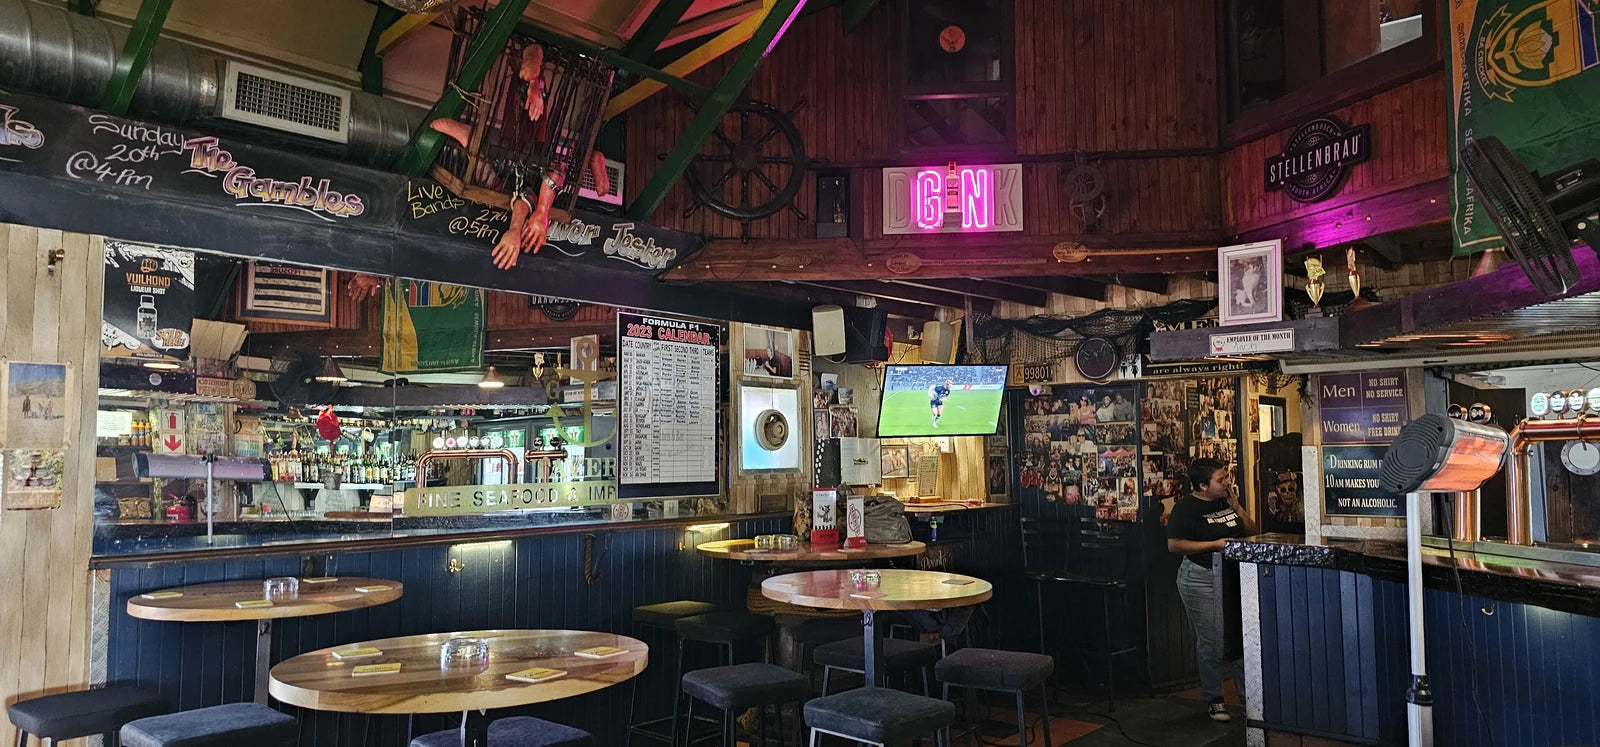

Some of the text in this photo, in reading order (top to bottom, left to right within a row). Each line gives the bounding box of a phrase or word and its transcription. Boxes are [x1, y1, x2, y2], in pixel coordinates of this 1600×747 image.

[1478, 50, 1490, 87] CRICKET
[88, 114, 185, 155] Sunday
[104, 144, 159, 163] 20th
[184, 136, 237, 172] The
[1270, 135, 1360, 183] STELLENBRAU
[222, 165, 365, 218] Gambles
[407, 181, 444, 202] Live
[1291, 174, 1335, 196] SOUTH AFRICA
[411, 194, 466, 219] Bands
[125, 271, 172, 288] VUILHOND
[130, 285, 166, 295] LIQUEUR SHOT
[642, 317, 687, 330] FORMULA
[155, 329, 182, 341] SOLD
[626, 322, 653, 339] 2023
[657, 326, 712, 346] CALENDAR
[1226, 331, 1291, 344] EMPLOYEE OF THE MONTH
[622, 339, 634, 348] DATE
[634, 341, 652, 350] COUNTRY
[661, 343, 673, 353] FIRST
[674, 345, 689, 354] SECOND
[689, 347, 699, 355] THIRD
[1024, 366, 1049, 380] 99801
[1152, 361, 1245, 375] are always right!
[1368, 377, 1399, 387] NO SHIRT
[1323, 384, 1356, 398] Men
[1366, 388, 1403, 399] NO SERVICE
[1372, 412, 1399, 423] NO SHIRT
[1323, 420, 1360, 433] Women
[1368, 427, 1383, 437] FREE
[1363, 460, 1378, 469] RUM
[1344, 478, 1366, 489] MAKES
[1366, 478, 1380, 489] YOU
[417, 491, 462, 510] FINE
[473, 487, 560, 509] SEAFOOD
[1338, 498, 1351, 507] NOT
[1351, 498, 1361, 508] AN
